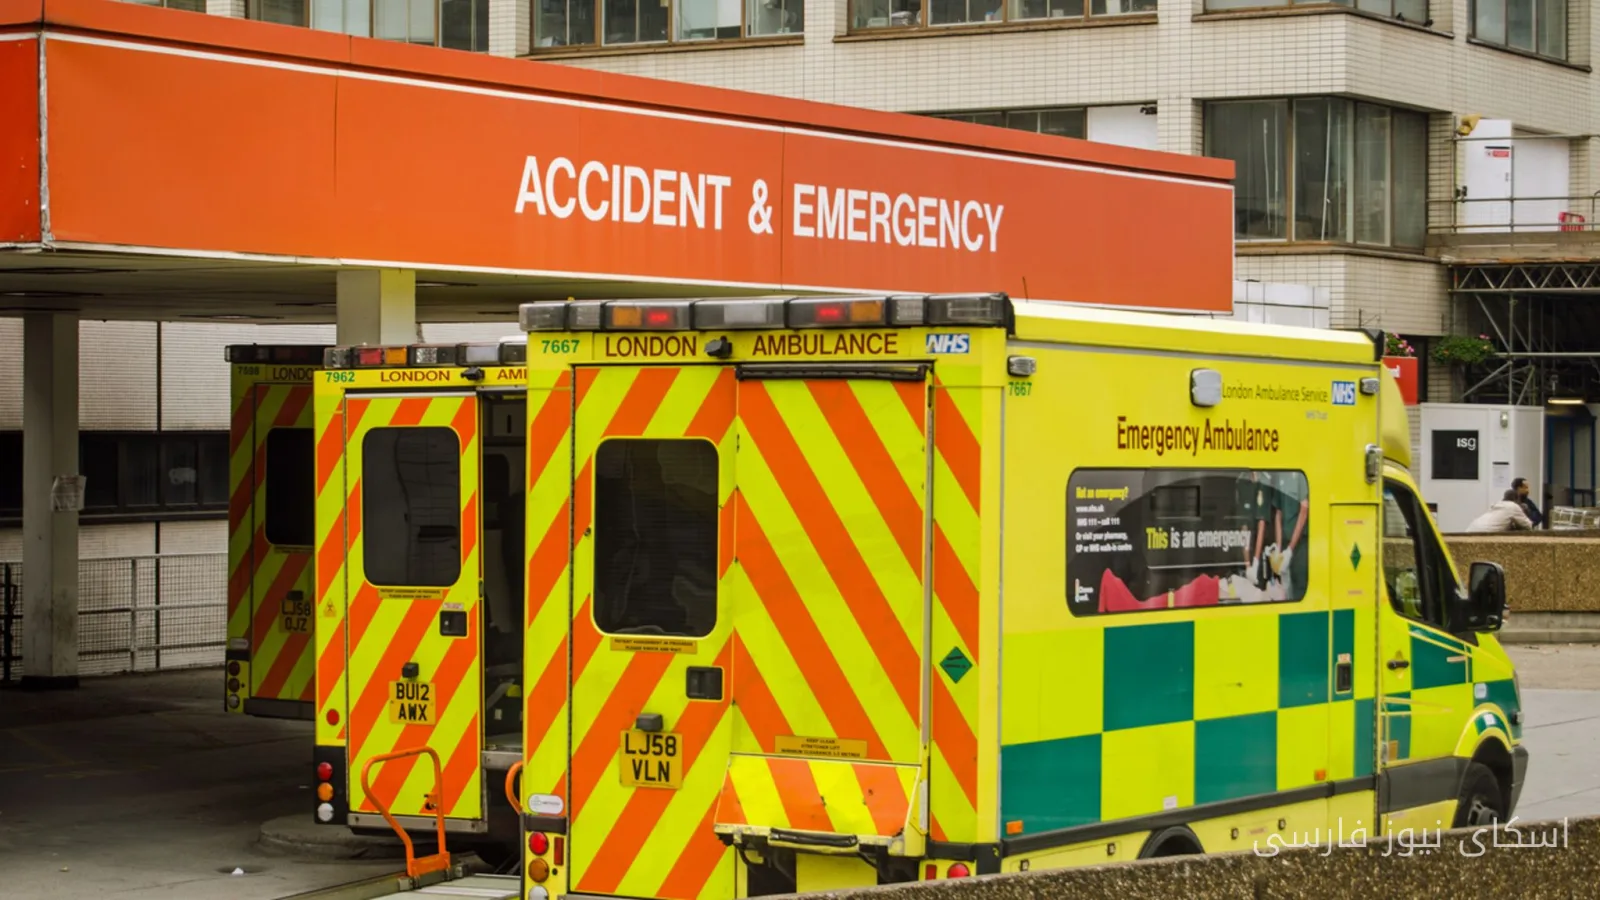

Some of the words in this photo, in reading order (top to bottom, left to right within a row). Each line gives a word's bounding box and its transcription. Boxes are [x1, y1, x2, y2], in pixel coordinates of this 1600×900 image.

[514, 154, 732, 230] ACCIDENT
[747, 178, 773, 235] &
[793, 183, 1004, 252] EMERGENCY
[541, 339, 580, 355] 7667
[605, 335, 697, 358] LONDON
[752, 332, 898, 357] AMBULANCE
[926, 334, 970, 354] NHS
[273, 366, 319, 380] LONDO
[325, 371, 356, 383] 7962
[380, 370, 450, 383] LONDON
[497, 368, 527, 380] AM
[1008, 381, 1032, 396] 7667
[1222, 381, 1253, 400] London
[1255, 384, 1300, 402] Ambulance
[1301, 386, 1328, 403] Service
[1332, 381, 1355, 405] NHS
[1117, 416, 1200, 456] Emergency
[1203, 418, 1279, 452] Ambulance
[1146, 527, 1168, 549] This
[1170, 527, 1181, 549] is
[1182, 531, 1195, 549] an
[1197, 529, 1251, 552] emergency
[396, 682, 430, 701] BU12
[398, 703, 428, 721] AWX
[624, 732, 677, 757] LJ58
[632, 758, 670, 782] VLN
